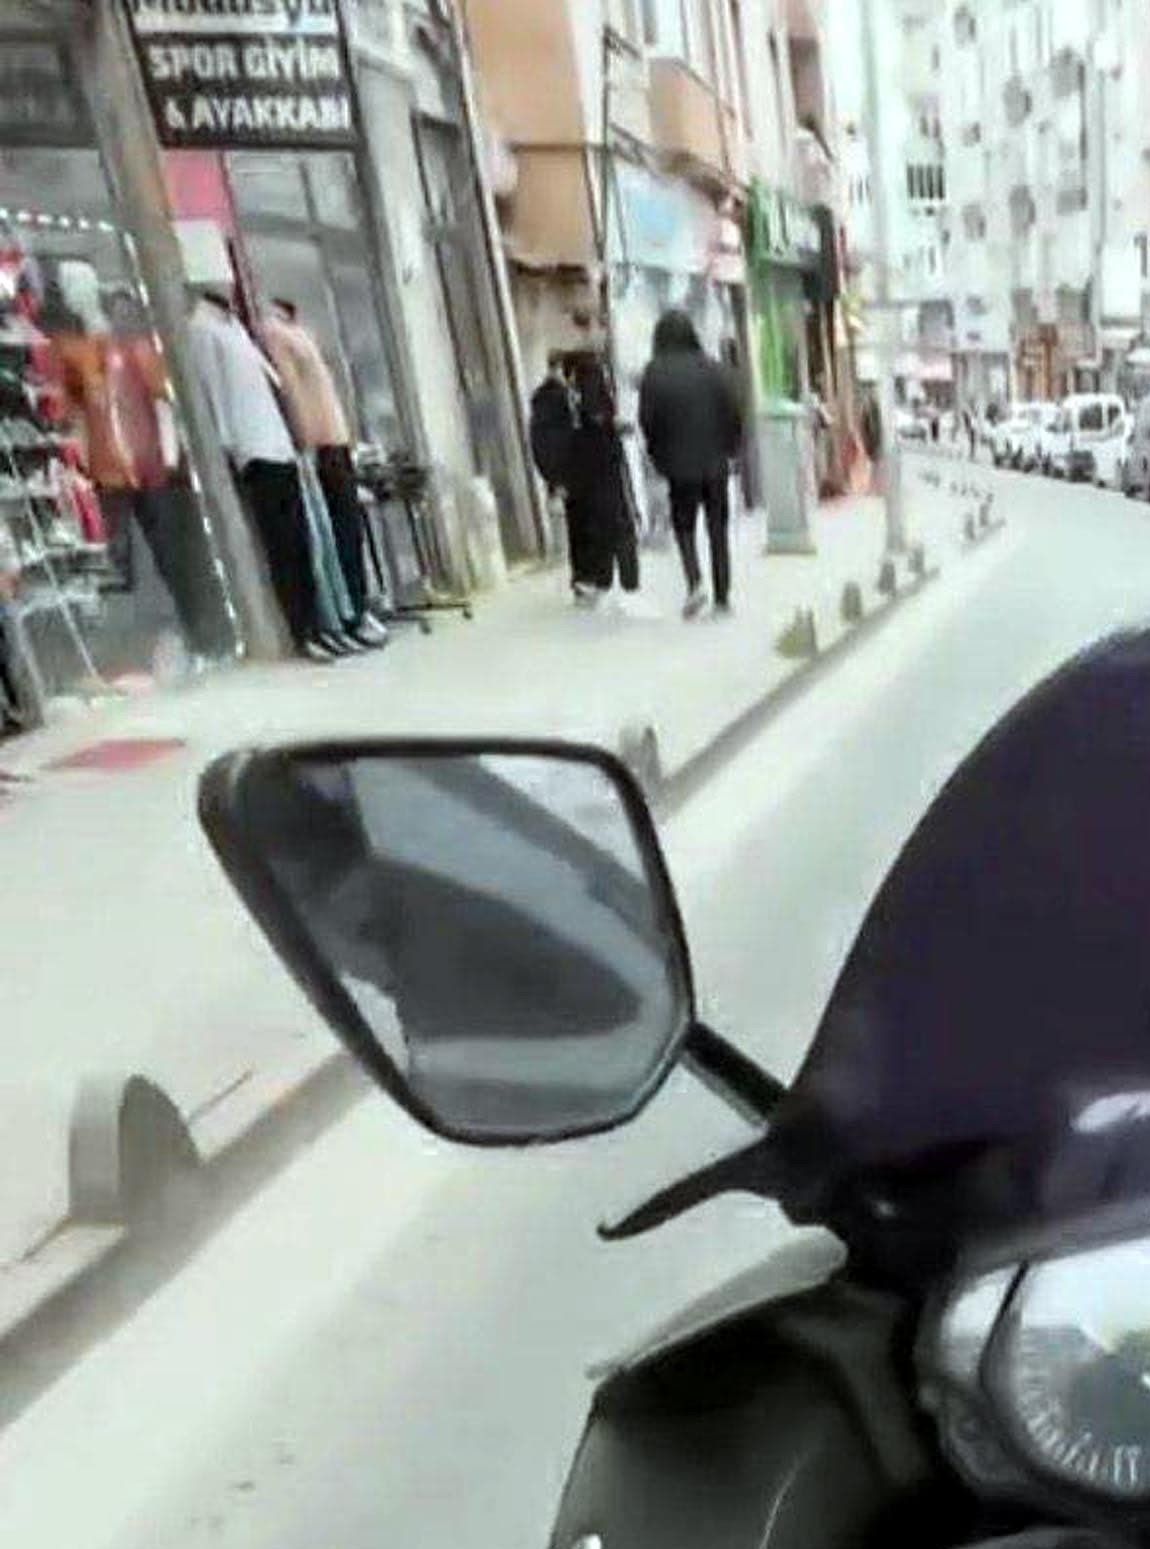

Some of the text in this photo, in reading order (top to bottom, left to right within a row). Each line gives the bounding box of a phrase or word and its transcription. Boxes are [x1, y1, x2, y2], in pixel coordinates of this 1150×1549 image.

[150, 36, 341, 80] SPOR GİYİM
[165, 94, 350, 131] & AYAKKABI
